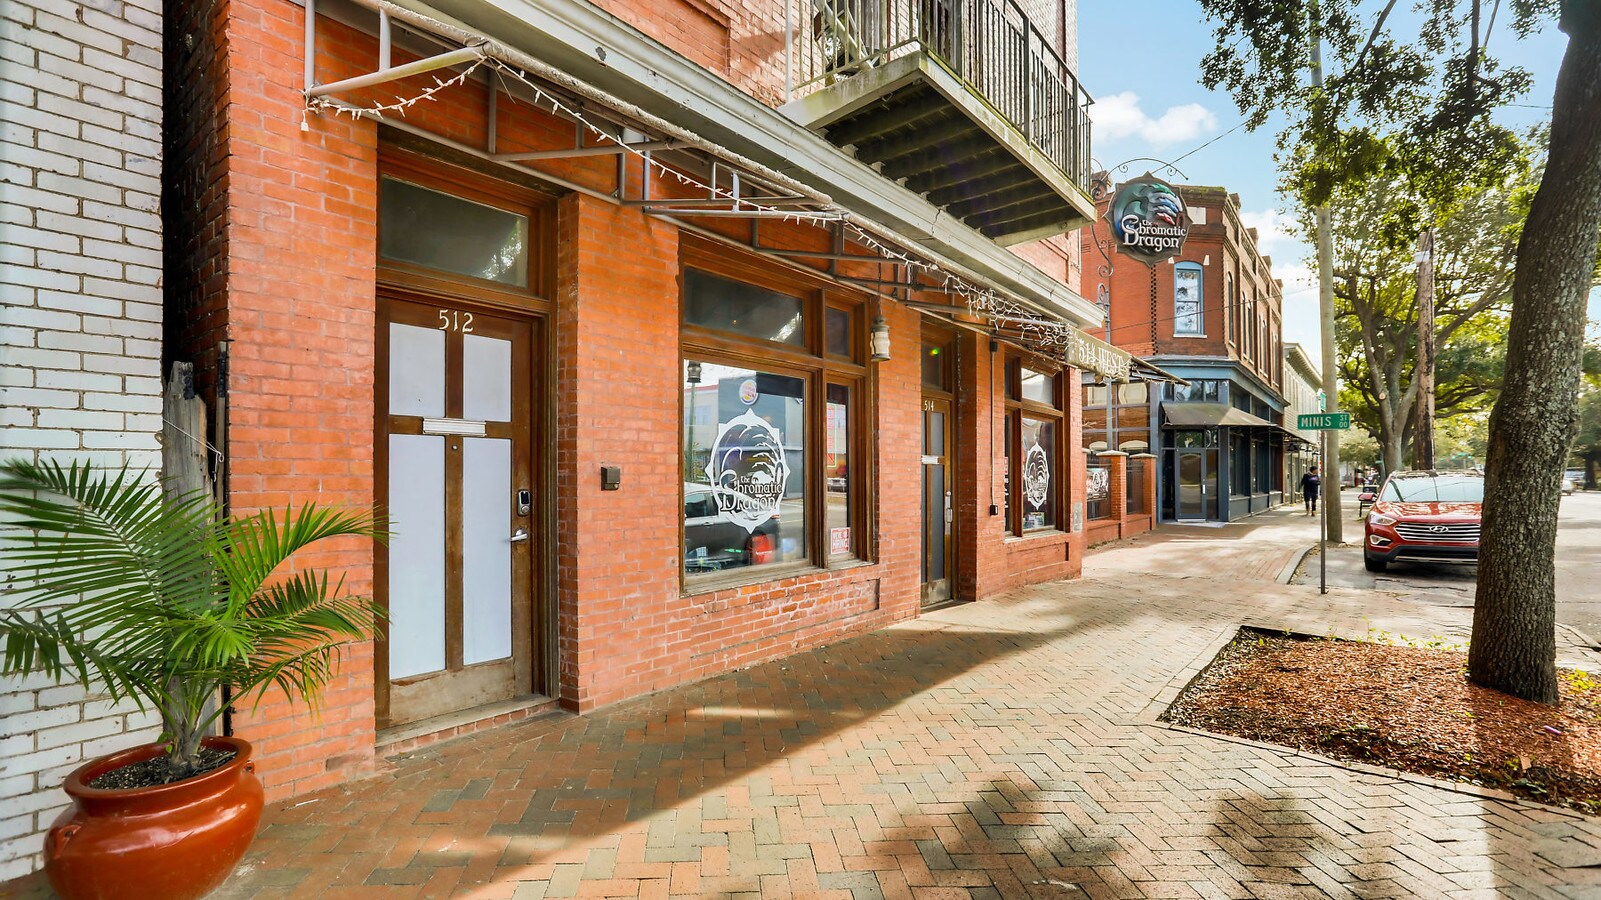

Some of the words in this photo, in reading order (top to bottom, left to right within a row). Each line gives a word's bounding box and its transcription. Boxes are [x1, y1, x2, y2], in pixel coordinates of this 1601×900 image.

[1121, 214, 1187, 236] Chromatic
[1123, 230, 1179, 252] Dragon
[439, 309, 474, 333] 512
[1098, 347, 1124, 374] WEST
[924, 400, 934, 411] 514
[1301, 416, 1332, 427] MINIS
[720, 469, 783, 495] Chromatic
[740, 475, 751, 483] the
[720, 493, 777, 518] Dragon
